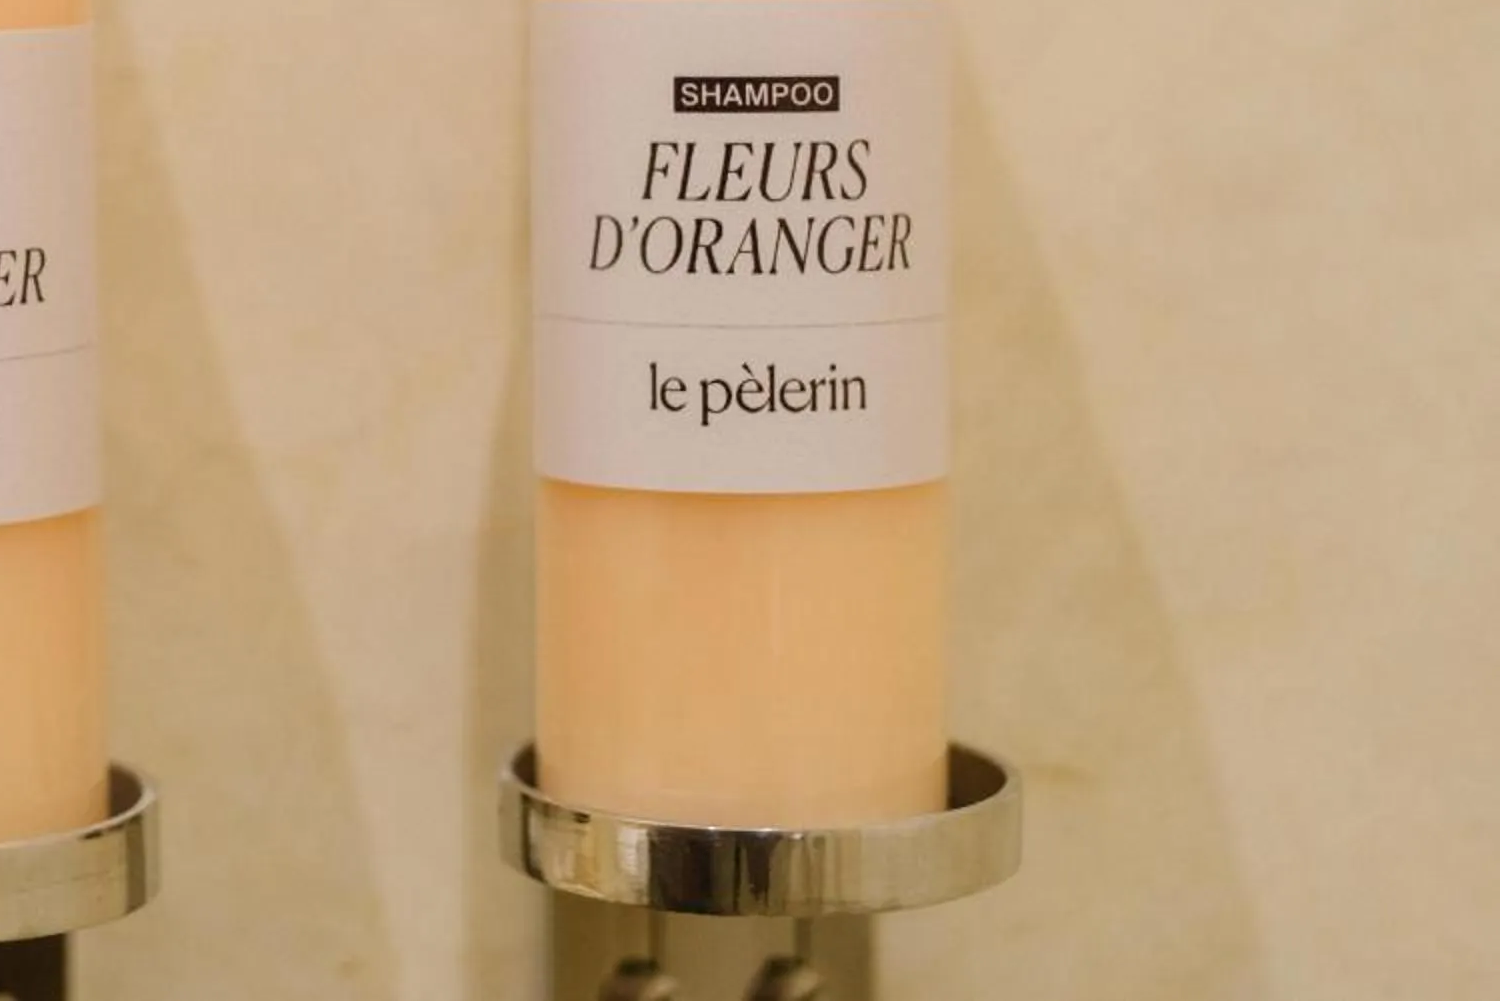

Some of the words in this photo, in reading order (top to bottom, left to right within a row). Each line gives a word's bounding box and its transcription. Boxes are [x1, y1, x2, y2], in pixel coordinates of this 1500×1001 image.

[680, 82, 834, 107] SHAMPOO
[641, 138, 871, 203] FLEURS
[589, 212, 912, 276] D’ORANGER
[648, 361, 687, 413] le
[699, 361, 867, 427] pèlerin
